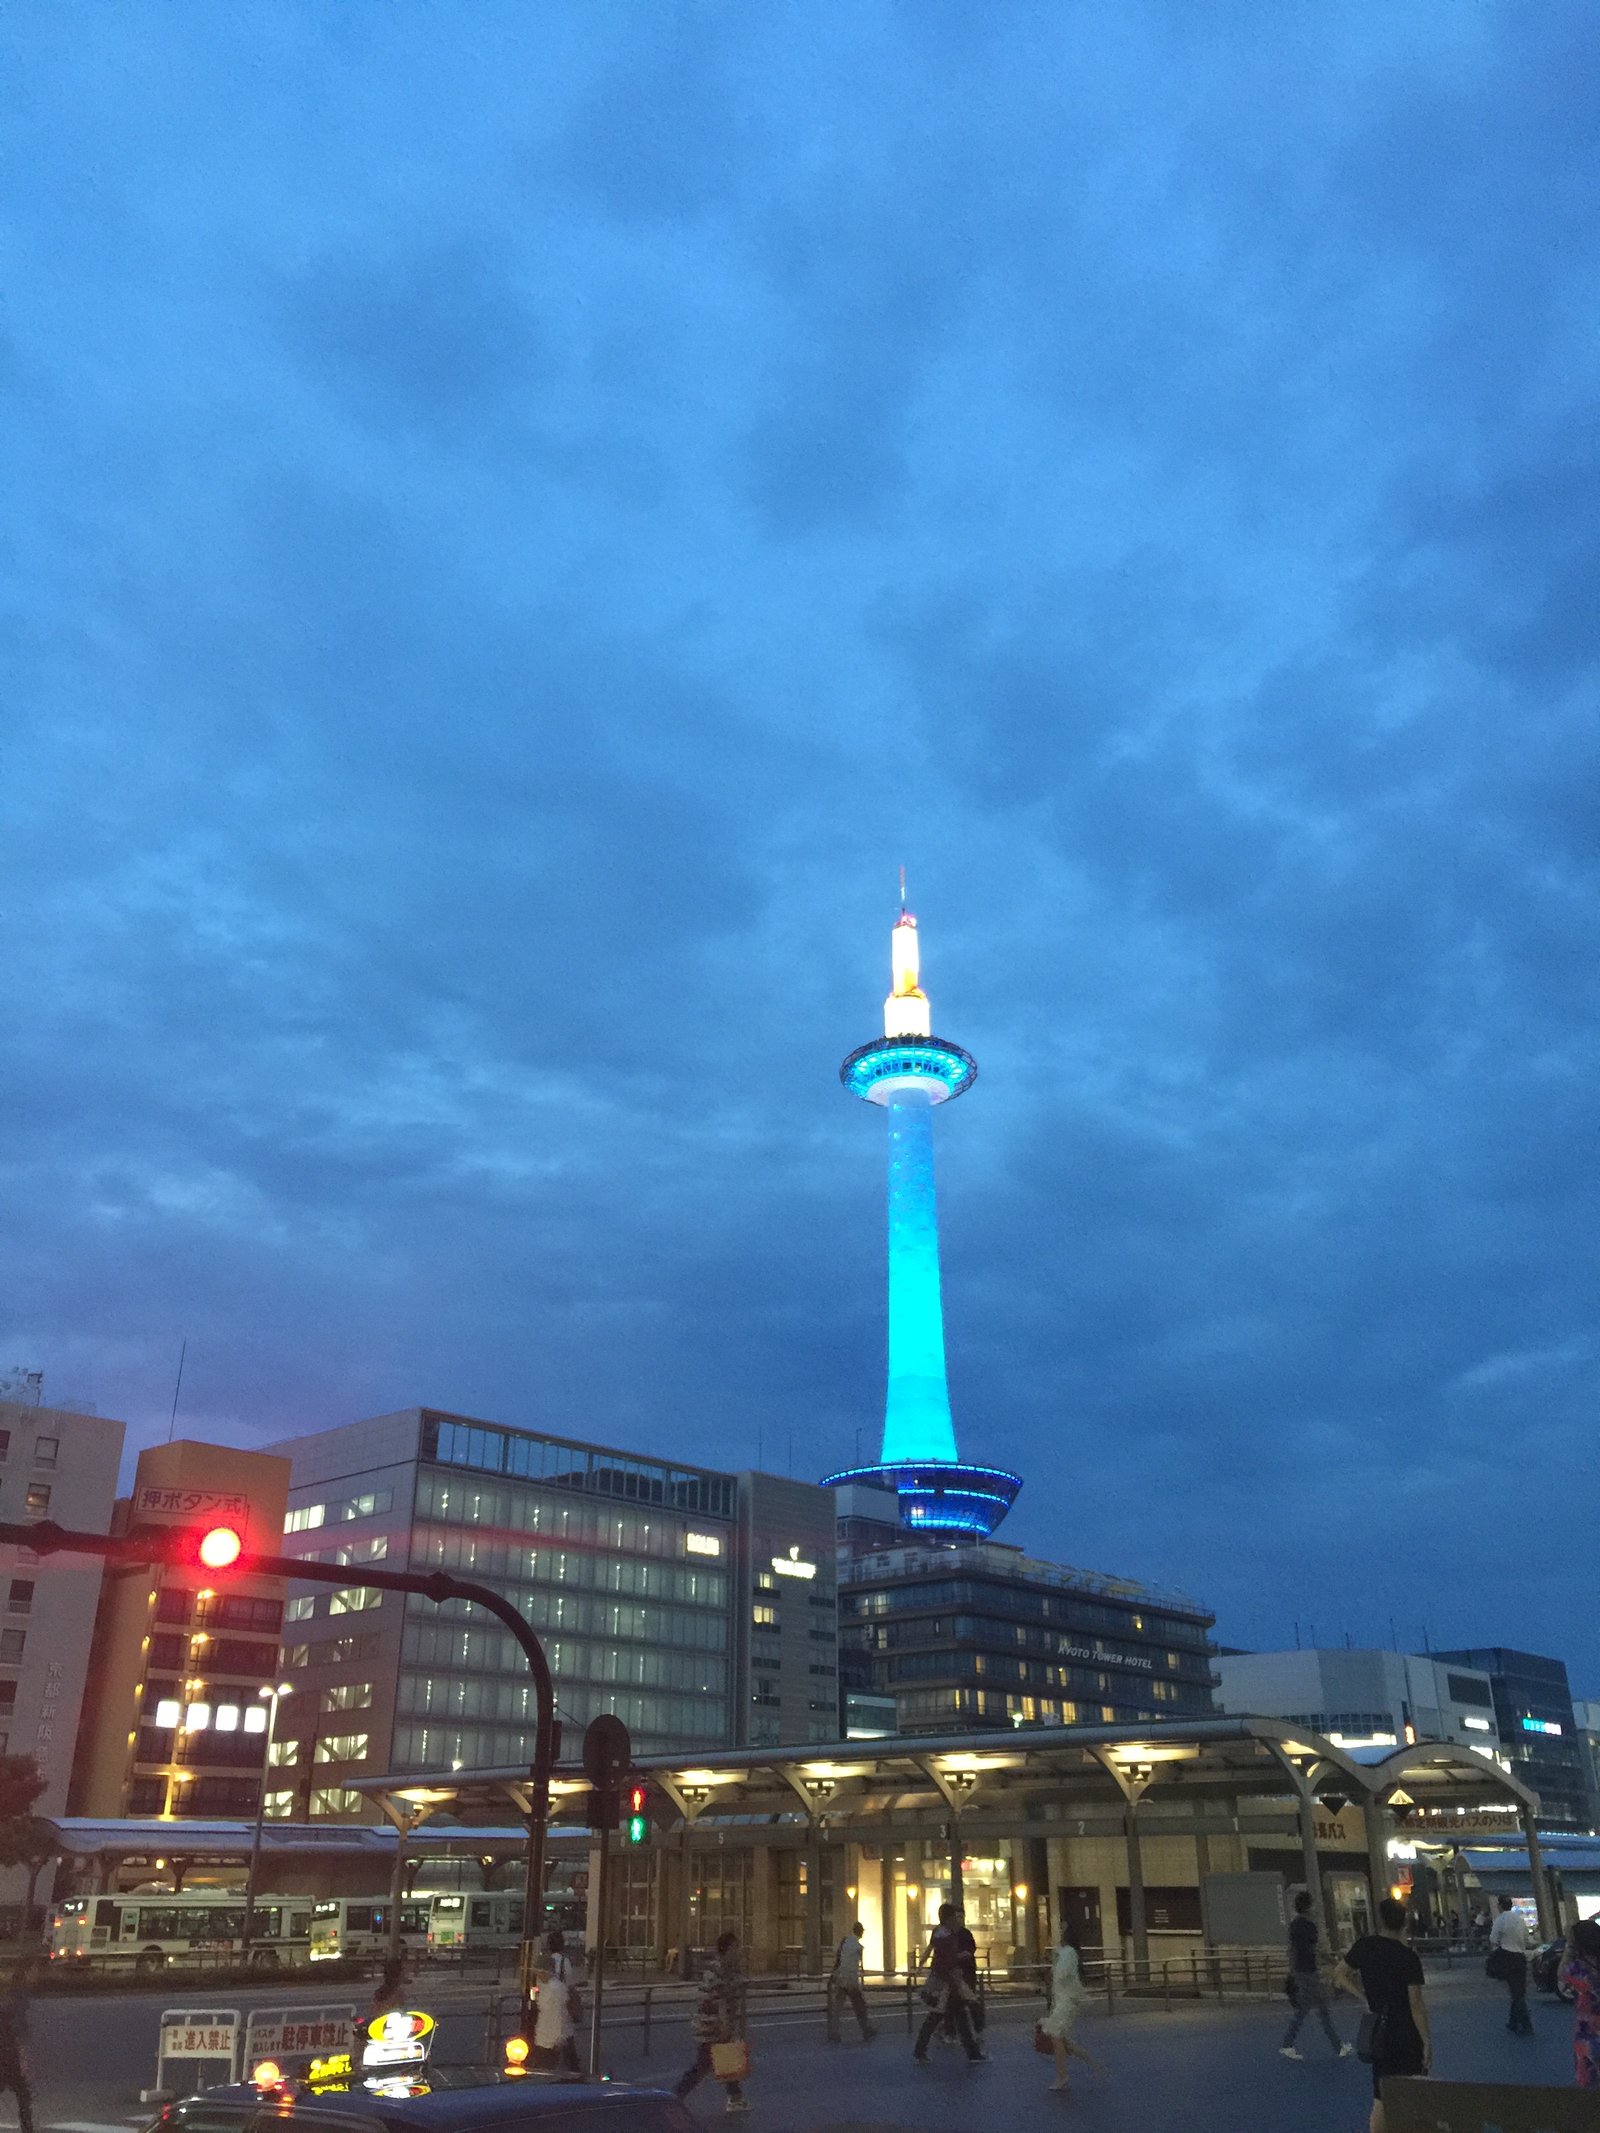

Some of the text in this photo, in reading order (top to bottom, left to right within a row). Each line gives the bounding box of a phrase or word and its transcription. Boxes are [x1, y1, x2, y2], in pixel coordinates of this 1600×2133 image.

[141, 1489, 242, 1514] 押ボタン式
[1057, 1645, 1153, 1669] KYOTO TOWER HOTEL
[939, 1825, 947, 1838] 3
[1077, 1820, 1085, 1835] 2
[1232, 1817, 1239, 1832] 1
[718, 1832, 724, 1845] 5
[822, 1829, 829, 1841] 4
[184, 2029, 231, 2051] 進入禁止
[281, 2022, 349, 2051] 駐停車禁止
